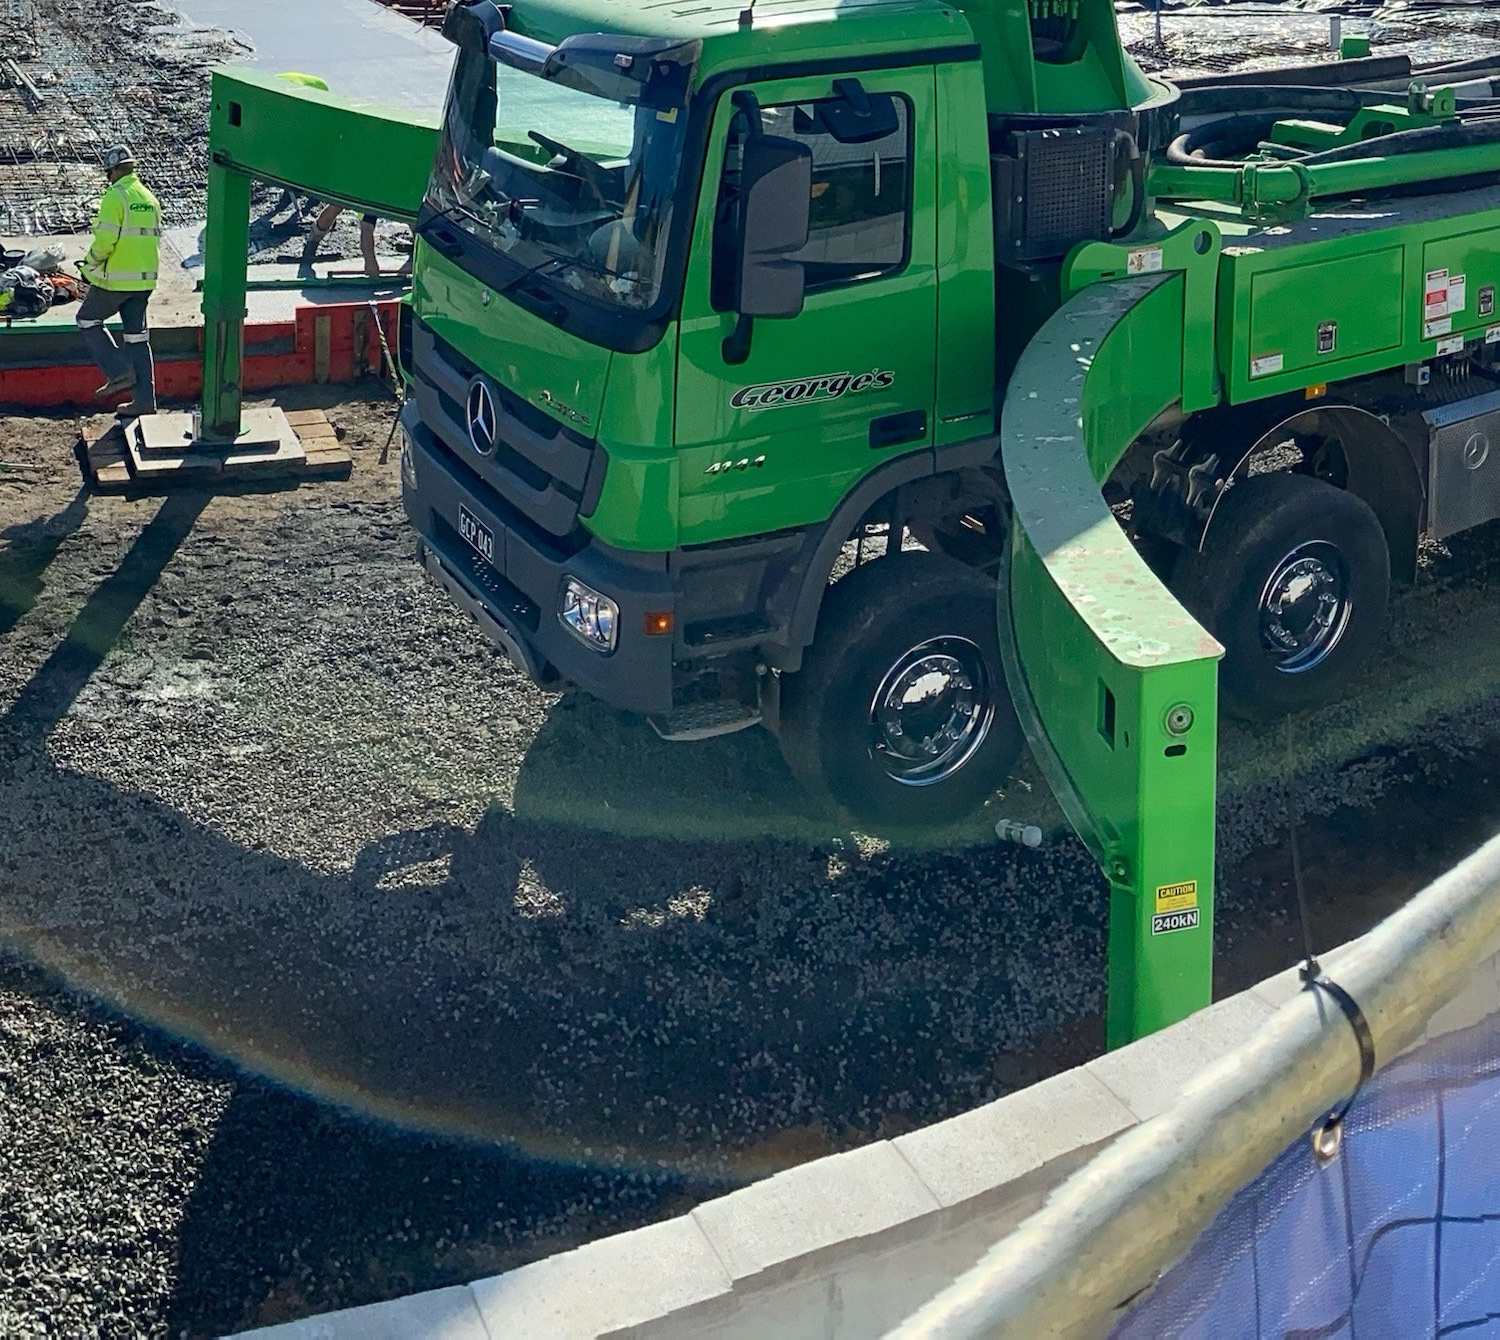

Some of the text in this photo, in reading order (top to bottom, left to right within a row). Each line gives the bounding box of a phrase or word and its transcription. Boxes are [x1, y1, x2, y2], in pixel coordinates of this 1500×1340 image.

[730, 367, 895, 413] George's
[703, 454, 766, 476] 4144
[460, 512, 493, 559] GCP 043
[1160, 883, 1194, 898] CAUTION
[1154, 912, 1197, 932] 240kN
